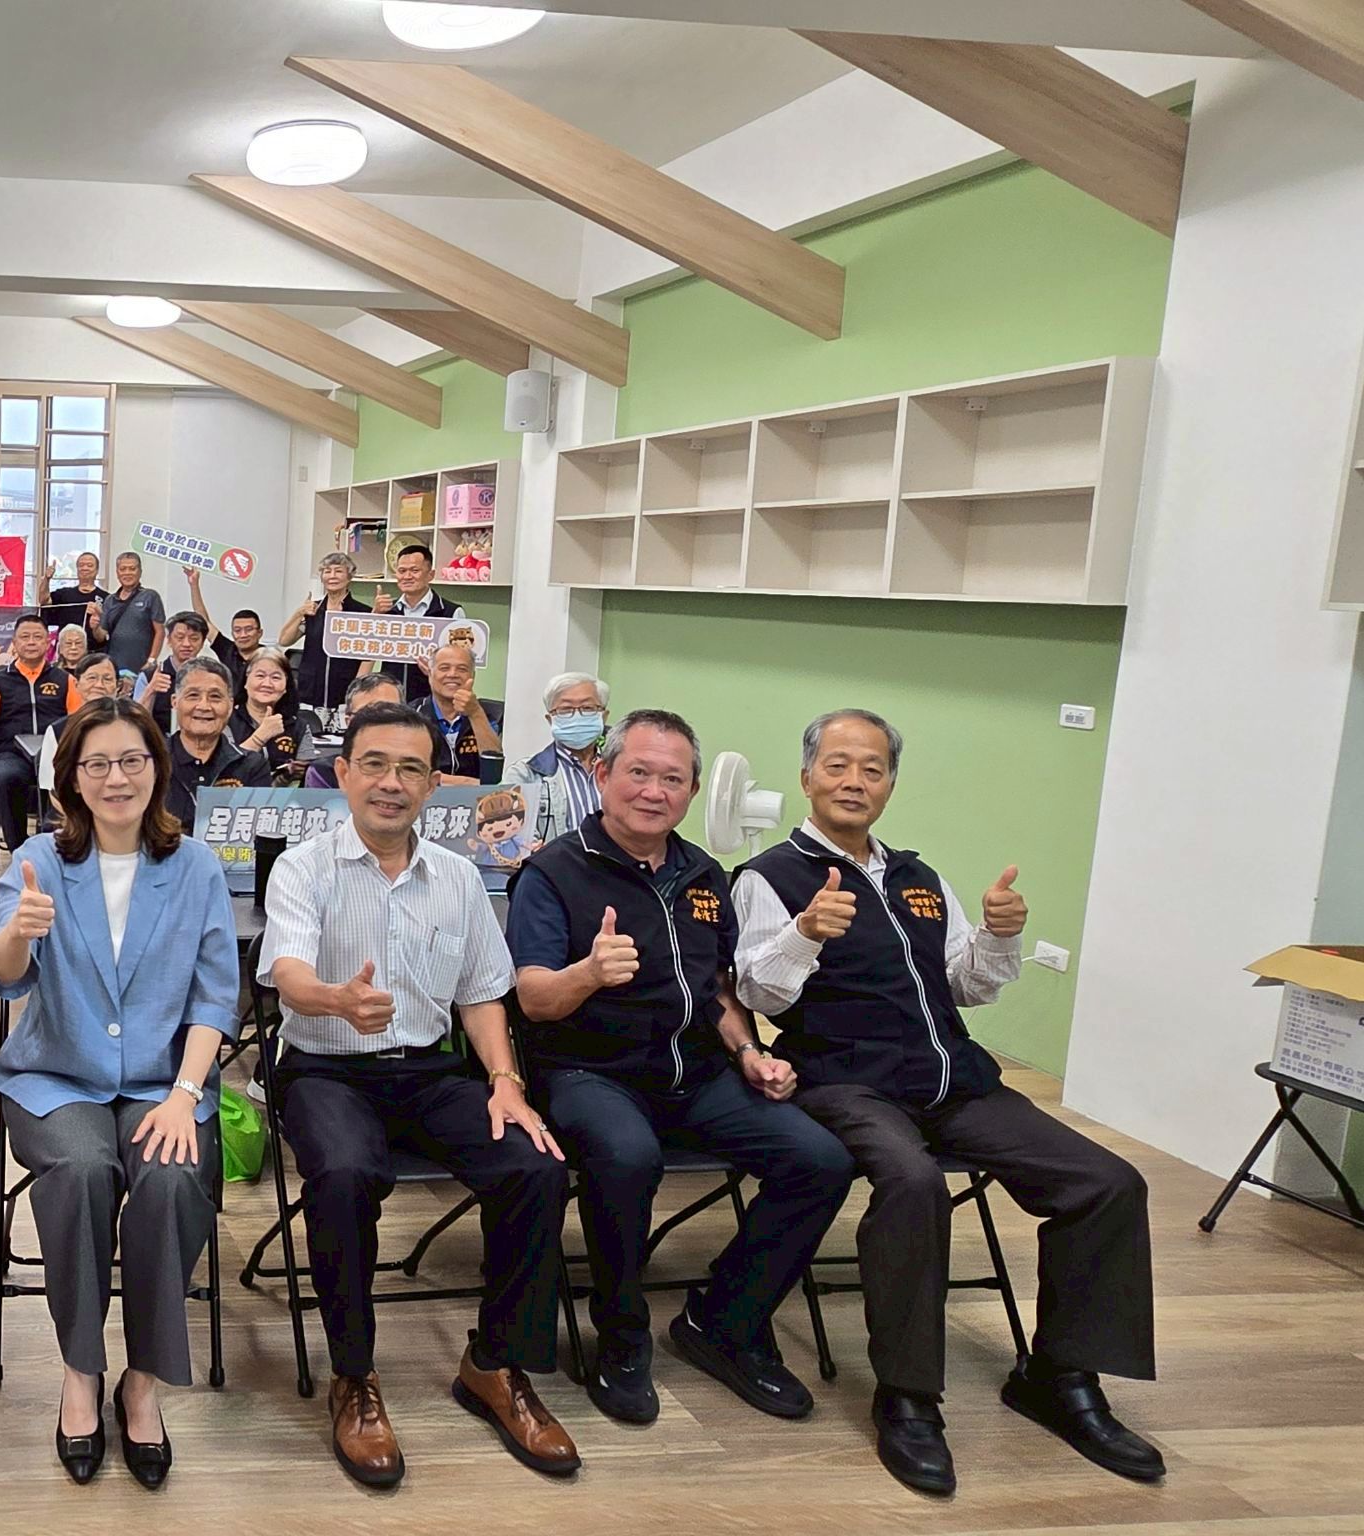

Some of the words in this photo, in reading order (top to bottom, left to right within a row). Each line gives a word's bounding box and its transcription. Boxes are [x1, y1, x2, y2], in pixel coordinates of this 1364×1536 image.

[140, 525, 211, 552] 吸毒等於自殺
[145, 541, 215, 569] 拒毒健康快樂
[331, 618, 434, 639] 詐騙手法日益新
